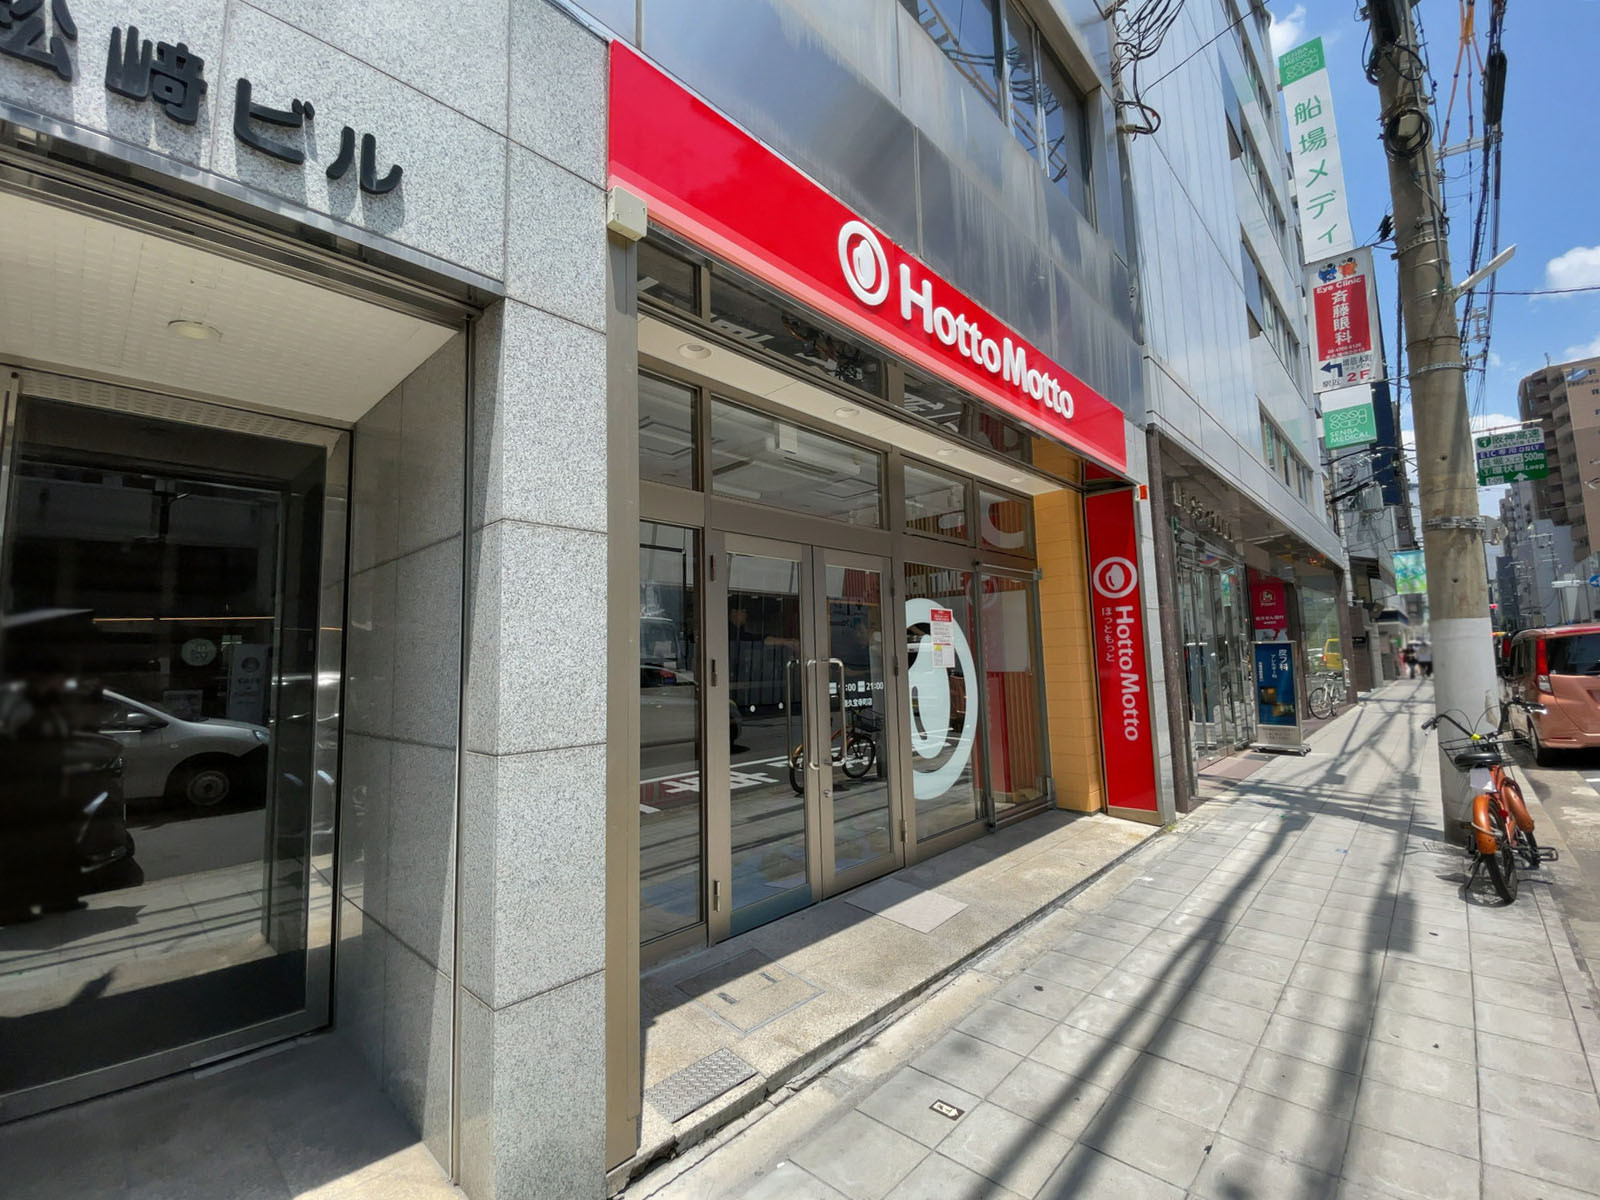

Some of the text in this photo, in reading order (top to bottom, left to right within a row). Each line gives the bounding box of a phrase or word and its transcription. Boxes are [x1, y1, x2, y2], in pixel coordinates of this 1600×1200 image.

[1294, 95, 1338, 244] 船場メディ
[1316, 278, 1361, 293] Eye Clinic
[899, 263, 1074, 419] HottoMotto
[1347, 369, 1371, 383] 2F
[1330, 427, 1359, 438] SENBA
[1330, 431, 1369, 444] MEDICAL
[1492, 429, 1540, 444] 阪神高速
[1480, 450, 1498, 458] ETC
[1524, 452, 1544, 462] 500m
[1101, 606, 1115, 662] ほっともっと
[1115, 605, 1140, 741] HottoMotto
